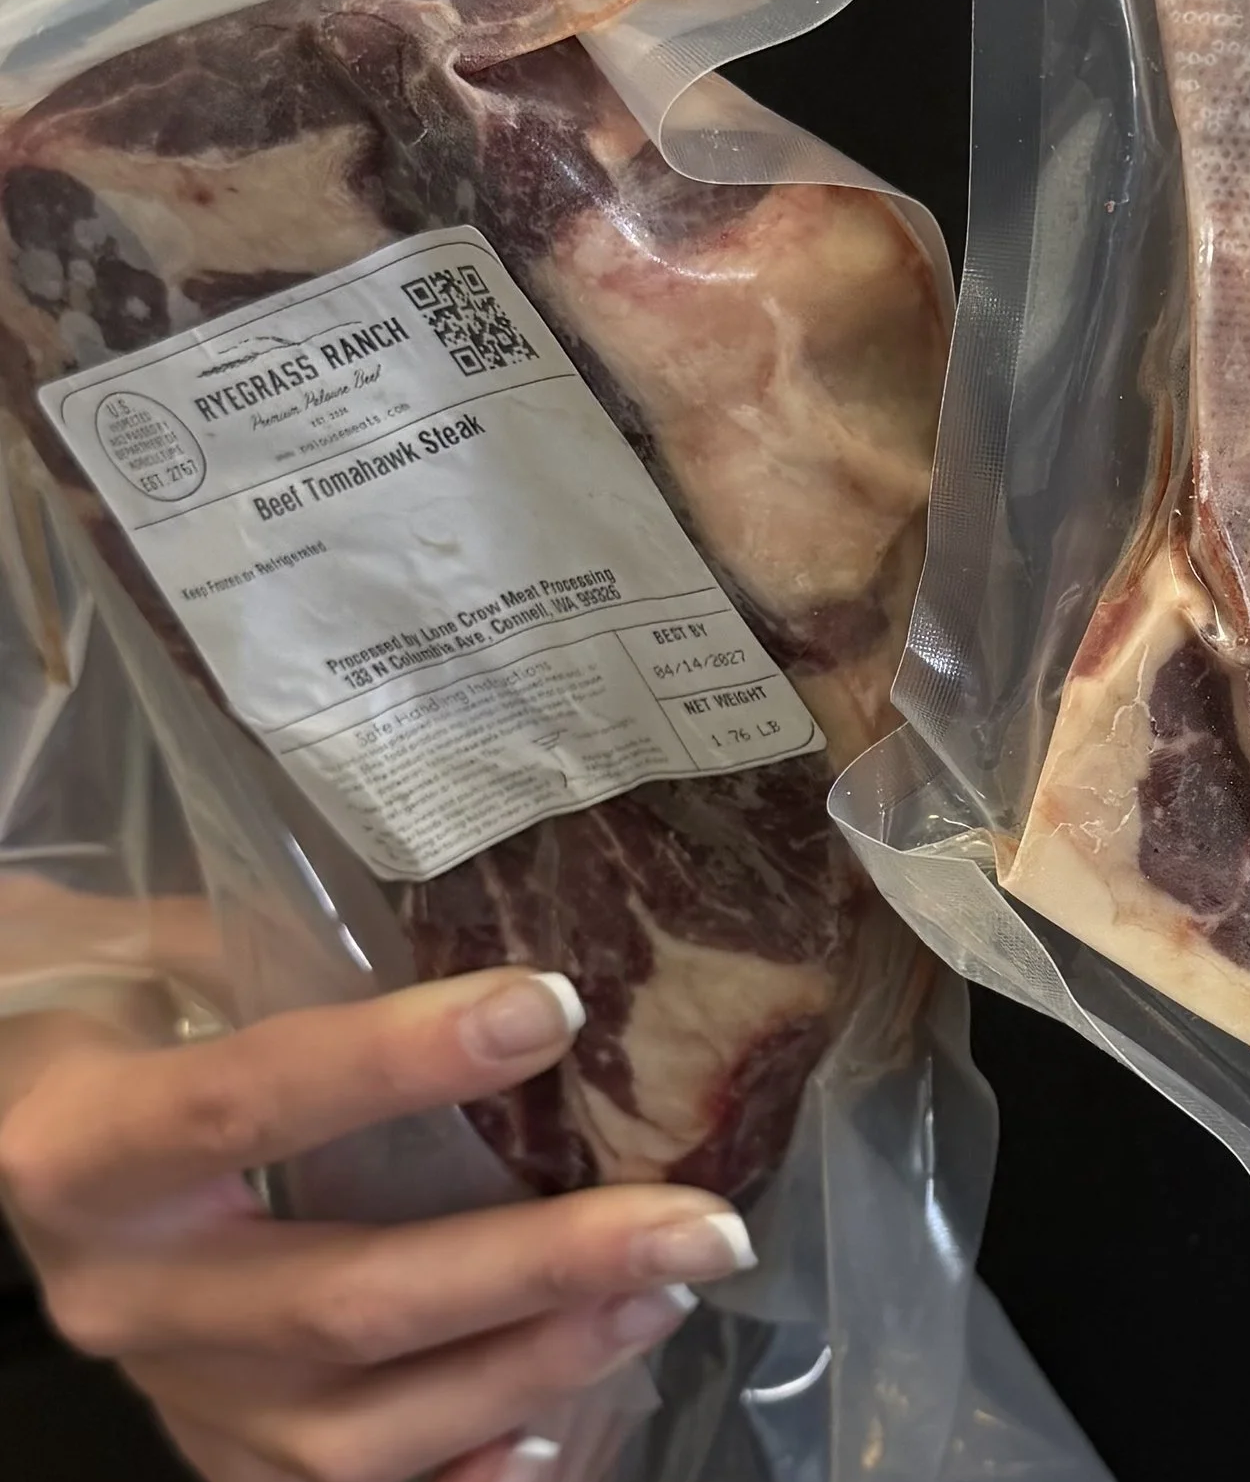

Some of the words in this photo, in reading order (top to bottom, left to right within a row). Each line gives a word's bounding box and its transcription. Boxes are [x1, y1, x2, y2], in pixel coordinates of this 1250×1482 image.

[193, 354, 320, 422] RYEGRASS
[319, 316, 410, 370] RANCH
[252, 485, 304, 521] Beef
[301, 441, 422, 501] Tomahawk
[417, 413, 486, 455] Steak
[325, 635, 402, 675] Processed
[400, 633, 422, 647] by
[419, 621, 458, 642] Lone
[456, 601, 501, 628] Crow
[499, 584, 540, 608] Meat
[538, 568, 617, 604] Processing
[343, 669, 374, 690] 133
[371, 661, 389, 678] N
[388, 643, 456, 670] Columbia
[550, 596, 579, 614] WA
[652, 626, 688, 645] BEST
[687, 623, 708, 638] BY
[683, 697, 711, 715] NET
[712, 679, 767, 709] WEIGHT
[756, 720, 781, 737] LB
